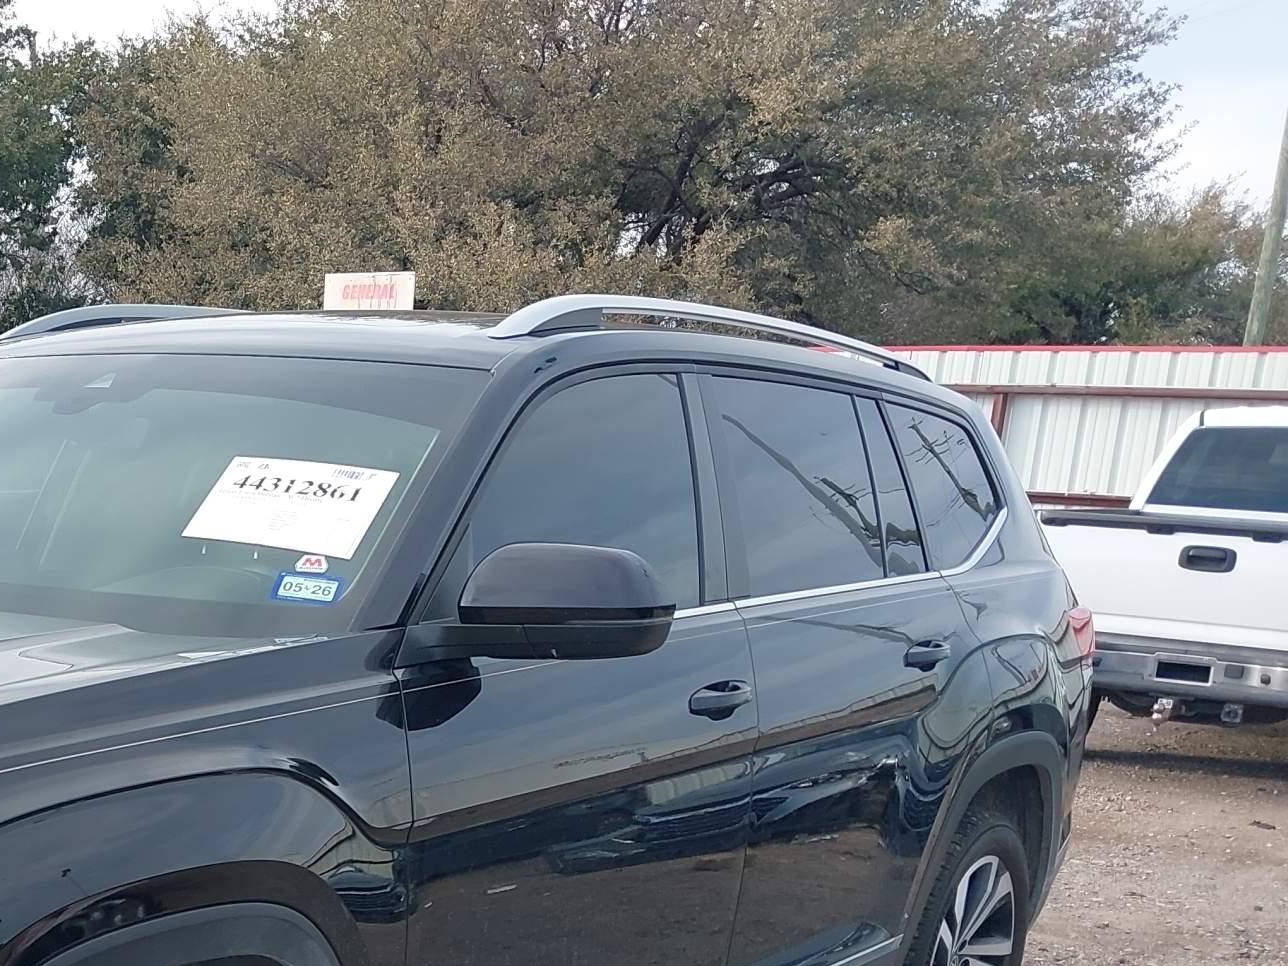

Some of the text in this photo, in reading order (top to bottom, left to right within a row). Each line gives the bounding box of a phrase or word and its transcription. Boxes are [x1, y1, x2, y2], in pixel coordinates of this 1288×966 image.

[233, 475, 362, 501] 44312861
[283, 582, 333, 597] 05 26
